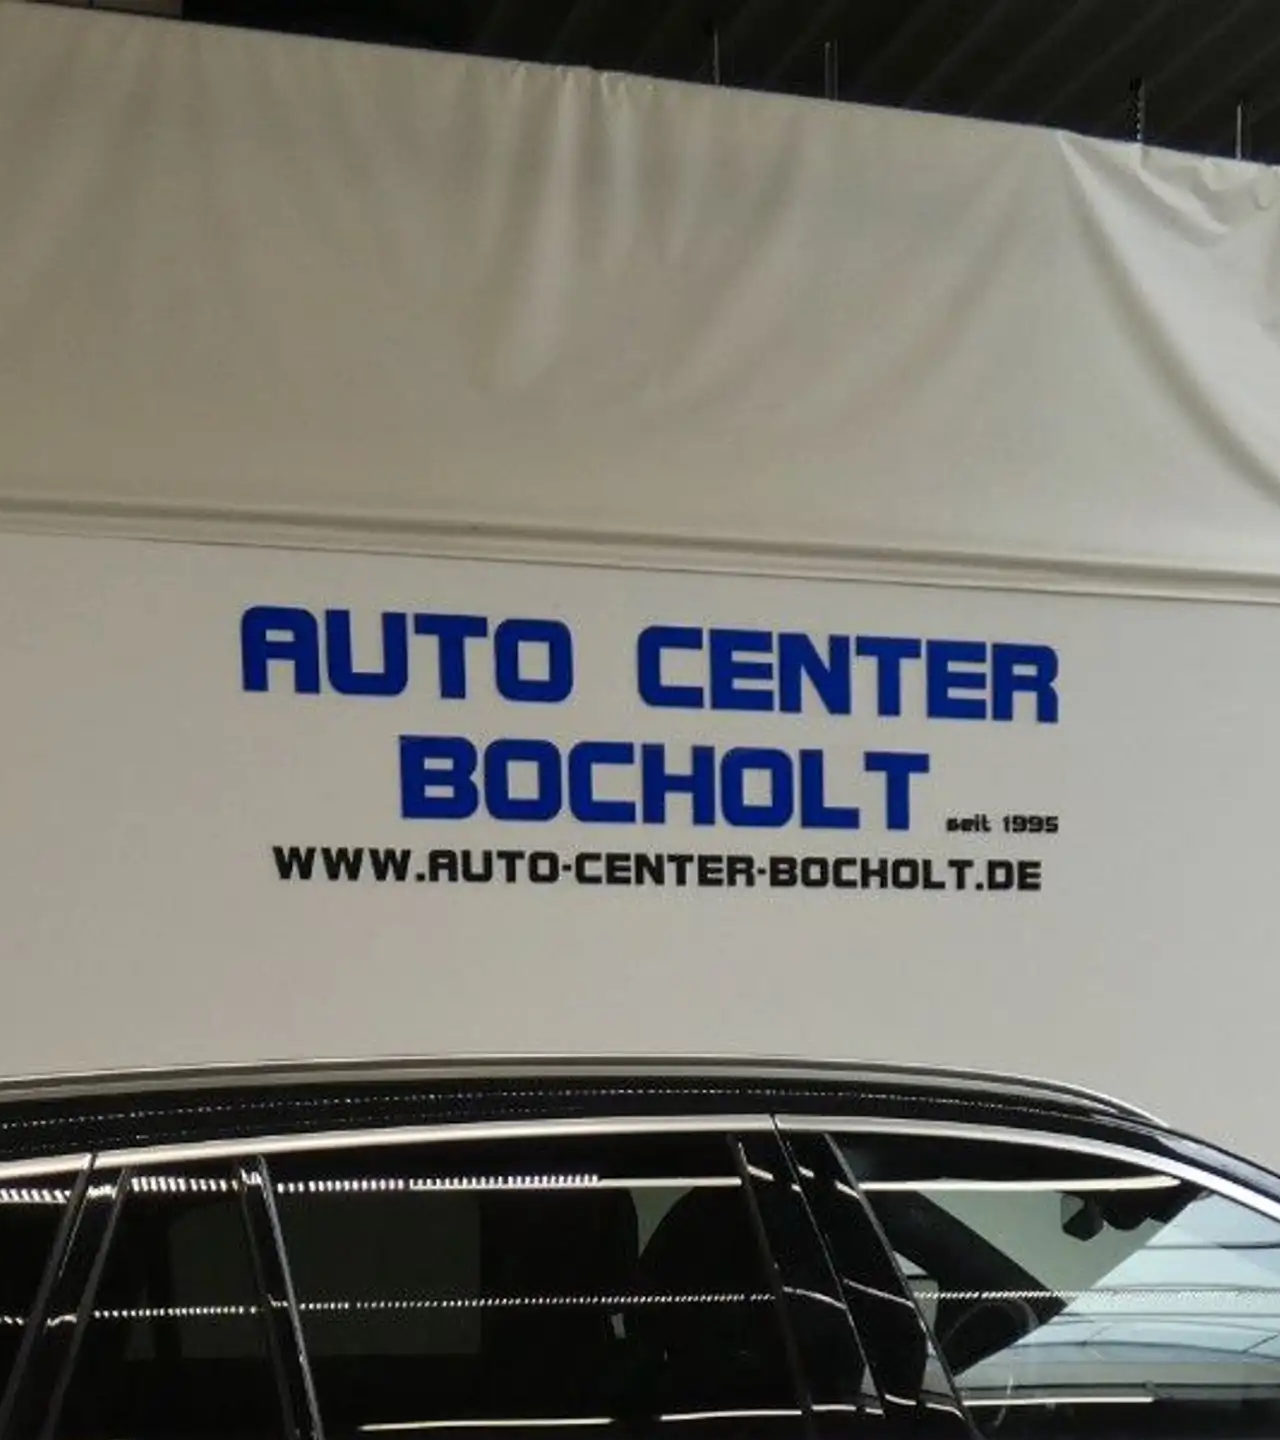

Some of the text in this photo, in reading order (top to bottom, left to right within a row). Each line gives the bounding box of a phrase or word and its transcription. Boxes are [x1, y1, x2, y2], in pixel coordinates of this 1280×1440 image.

[241, 606, 1059, 723] AUTO CENTER
[399, 735, 930, 830] BOCHOLT
[946, 813, 1059, 833] seit 1995
[273, 846, 1042, 891] WWW.AUTO-CENTER-BOCHOLT.DE
